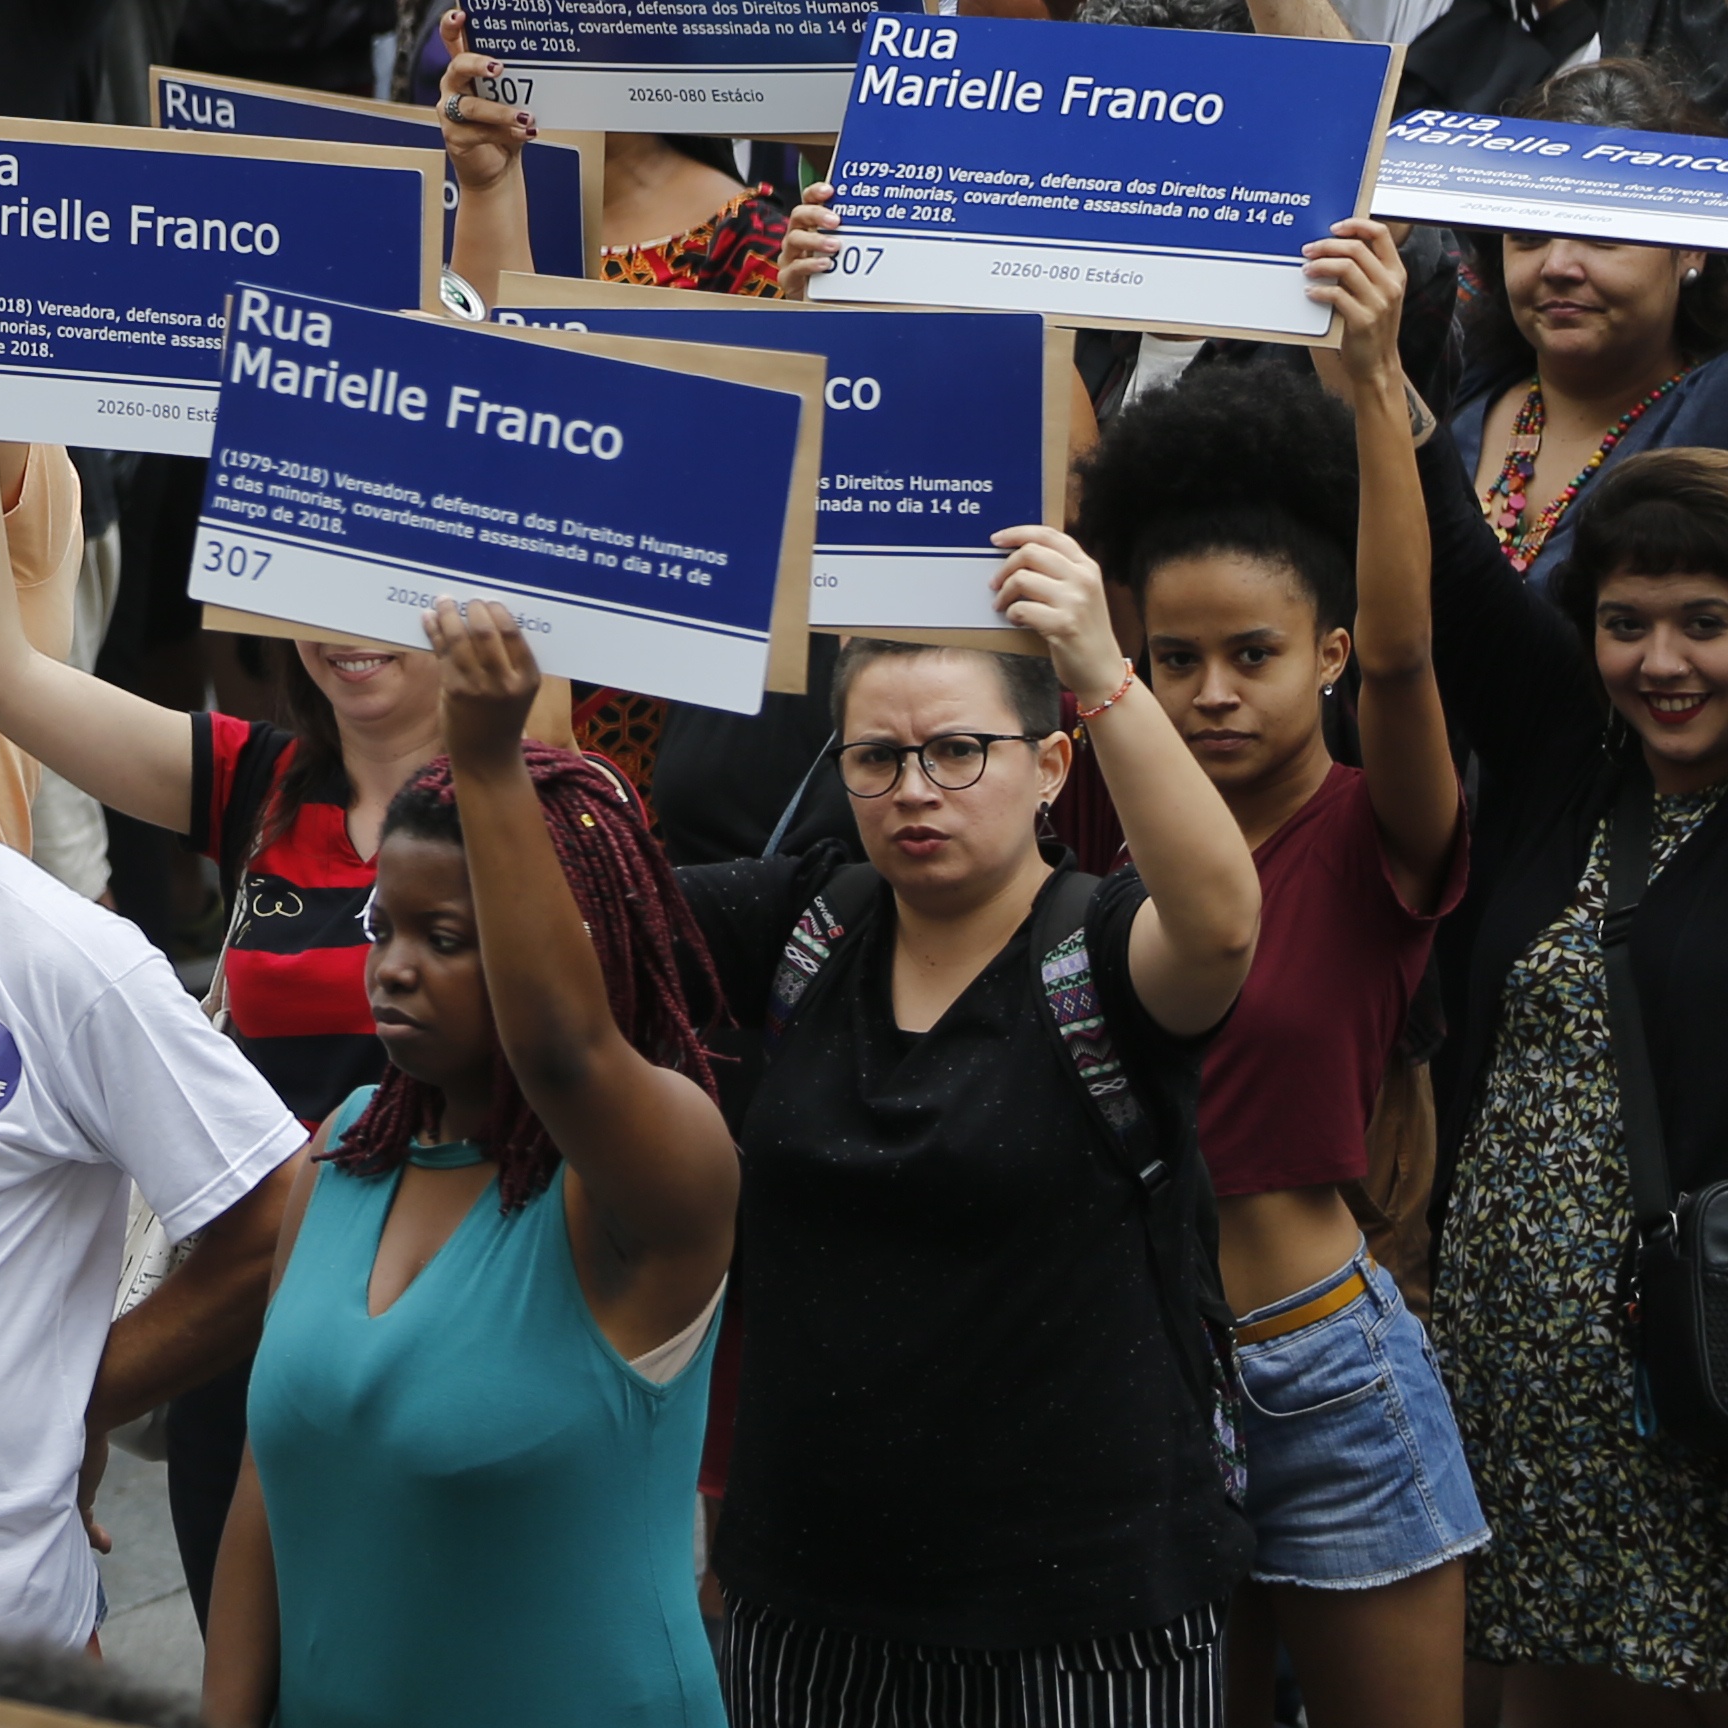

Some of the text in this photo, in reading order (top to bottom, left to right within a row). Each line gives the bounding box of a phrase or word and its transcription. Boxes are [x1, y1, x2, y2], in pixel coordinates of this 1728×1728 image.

[870, 18, 957, 59] Rua
[479, 73, 533, 105] 307
[859, 65, 1223, 124] Marielle Franco
[1387, 124, 1571, 157] Marielle
[1406, 109, 1501, 133] Rua
[131, 205, 279, 255] Franco
[237, 288, 333, 349] Rua
[231, 342, 623, 460] Marielle Franco
[204, 541, 272, 580] 307
